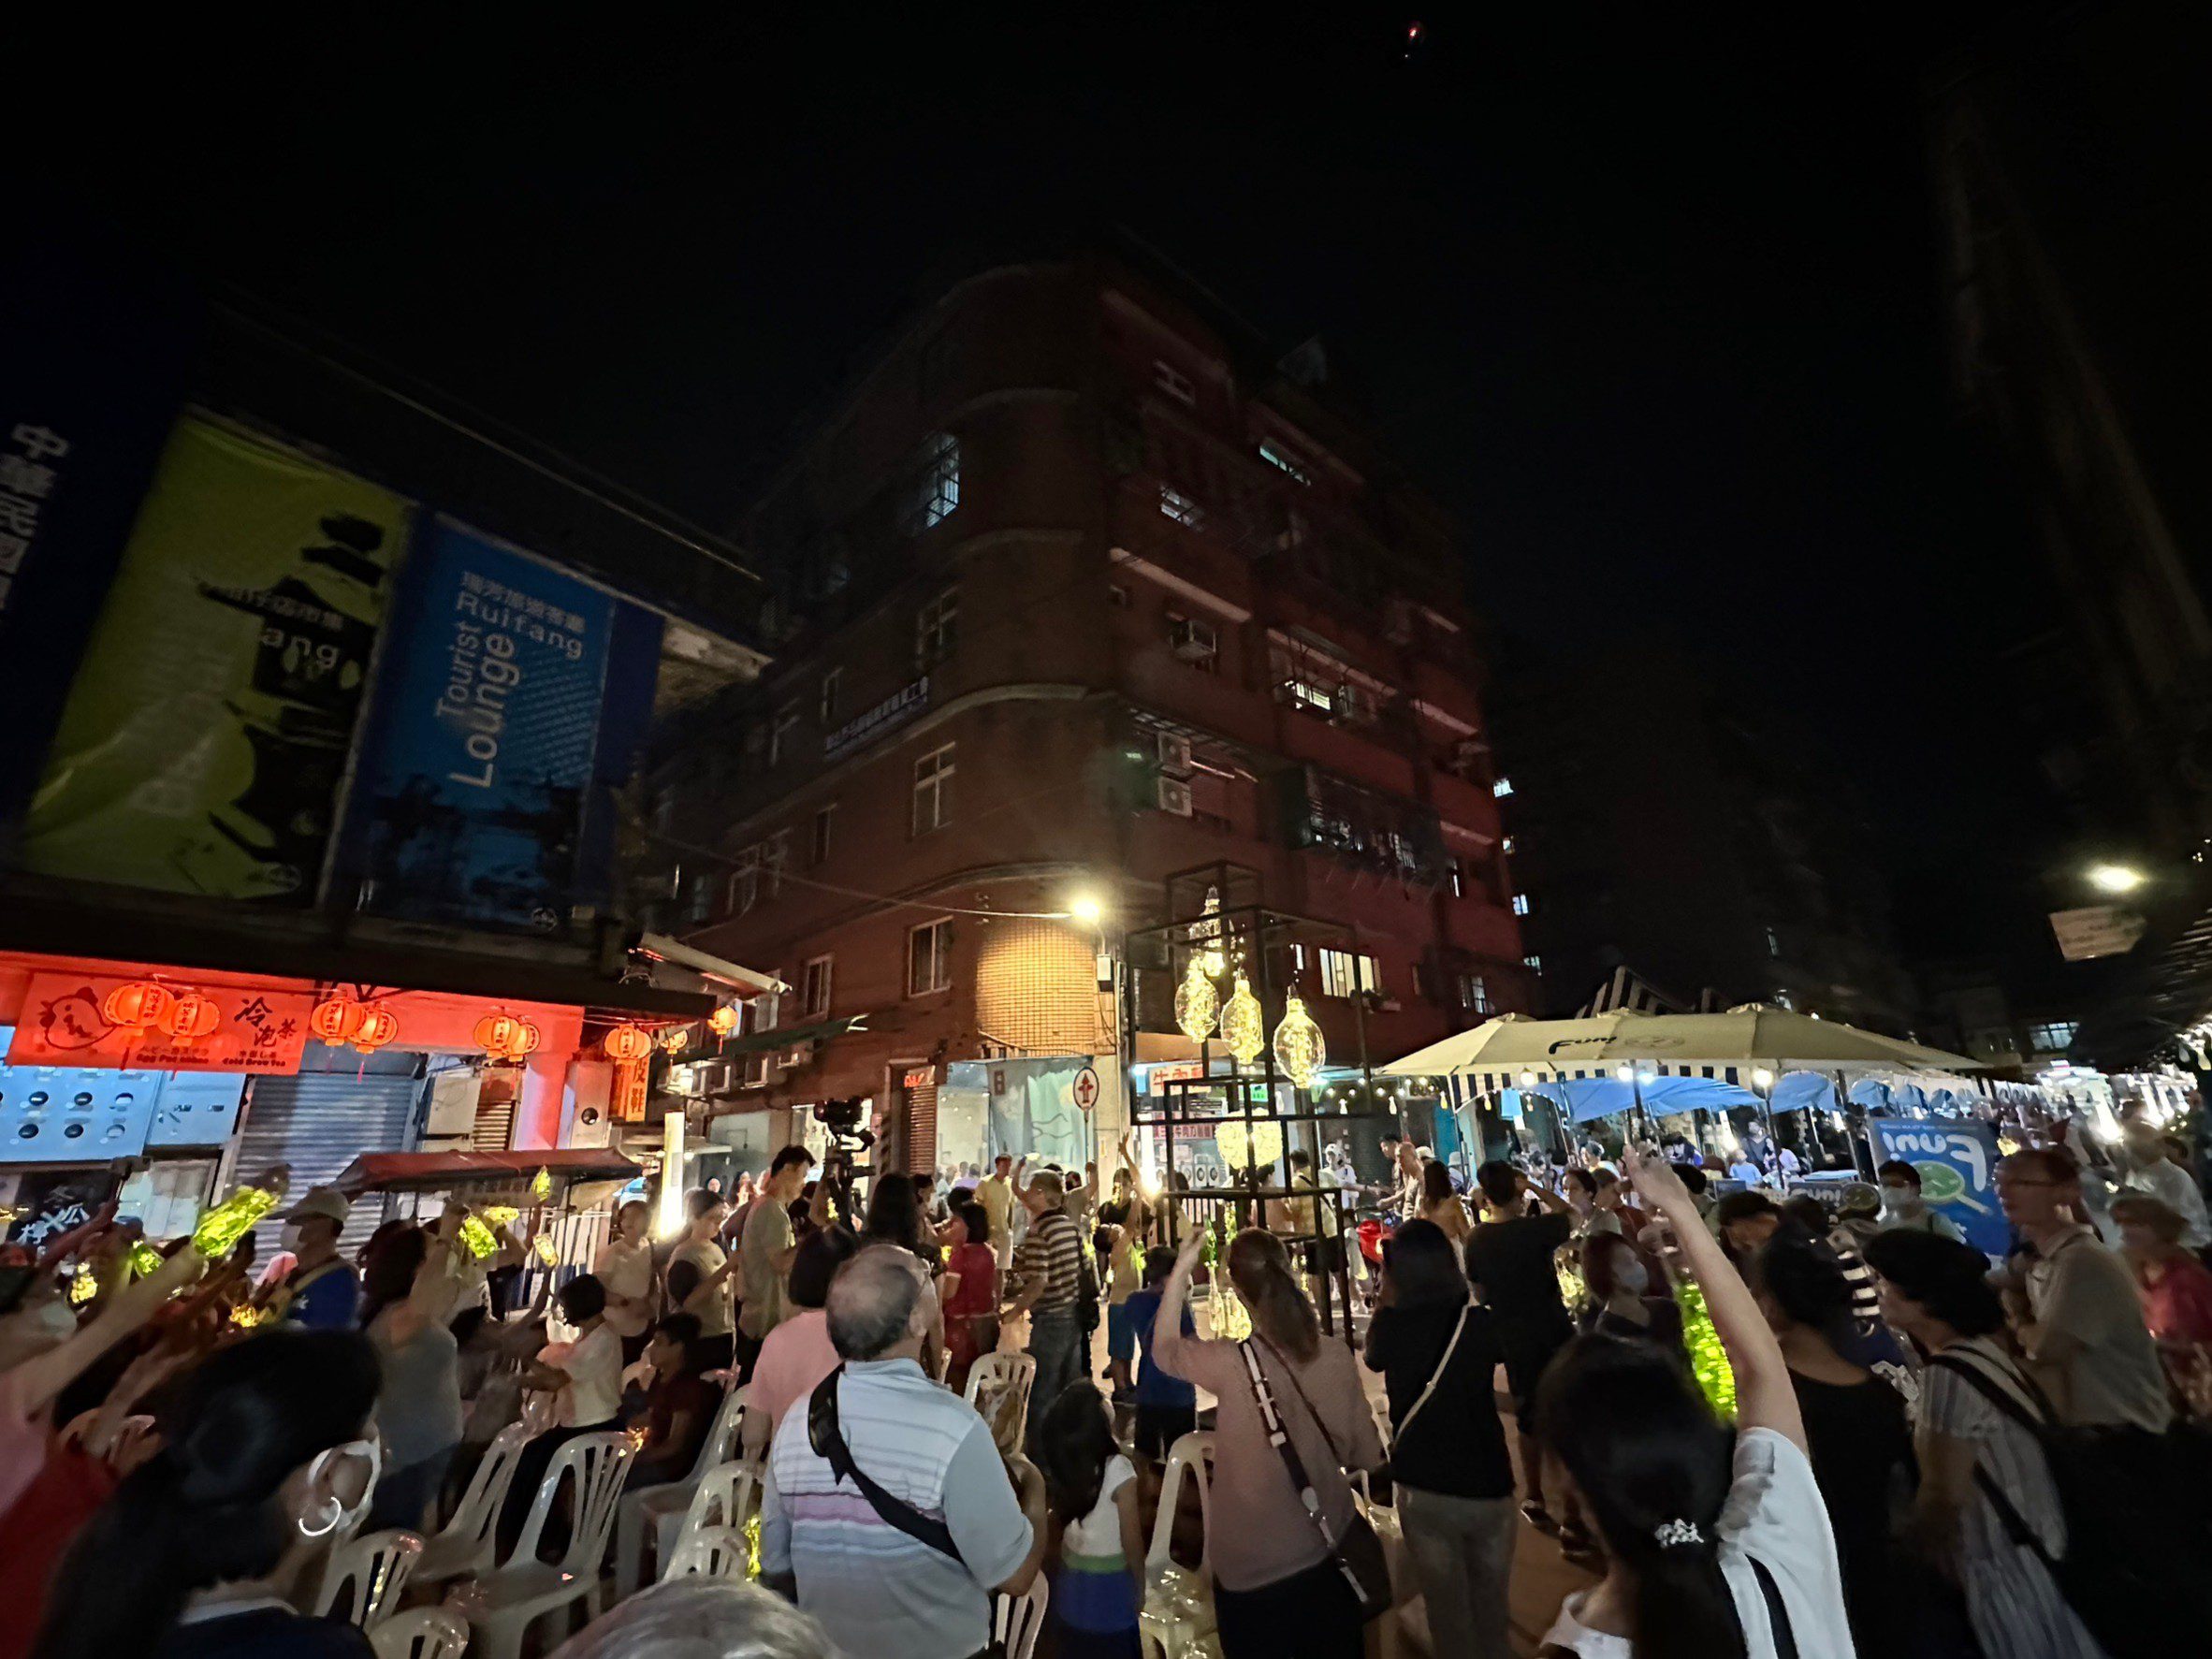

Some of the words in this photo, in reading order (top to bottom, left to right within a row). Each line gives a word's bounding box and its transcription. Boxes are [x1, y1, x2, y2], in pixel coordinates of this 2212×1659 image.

[434, 619, 483, 718] Tourist
[456, 590, 583, 662] Ruifang
[447, 633, 521, 788] Lounge
